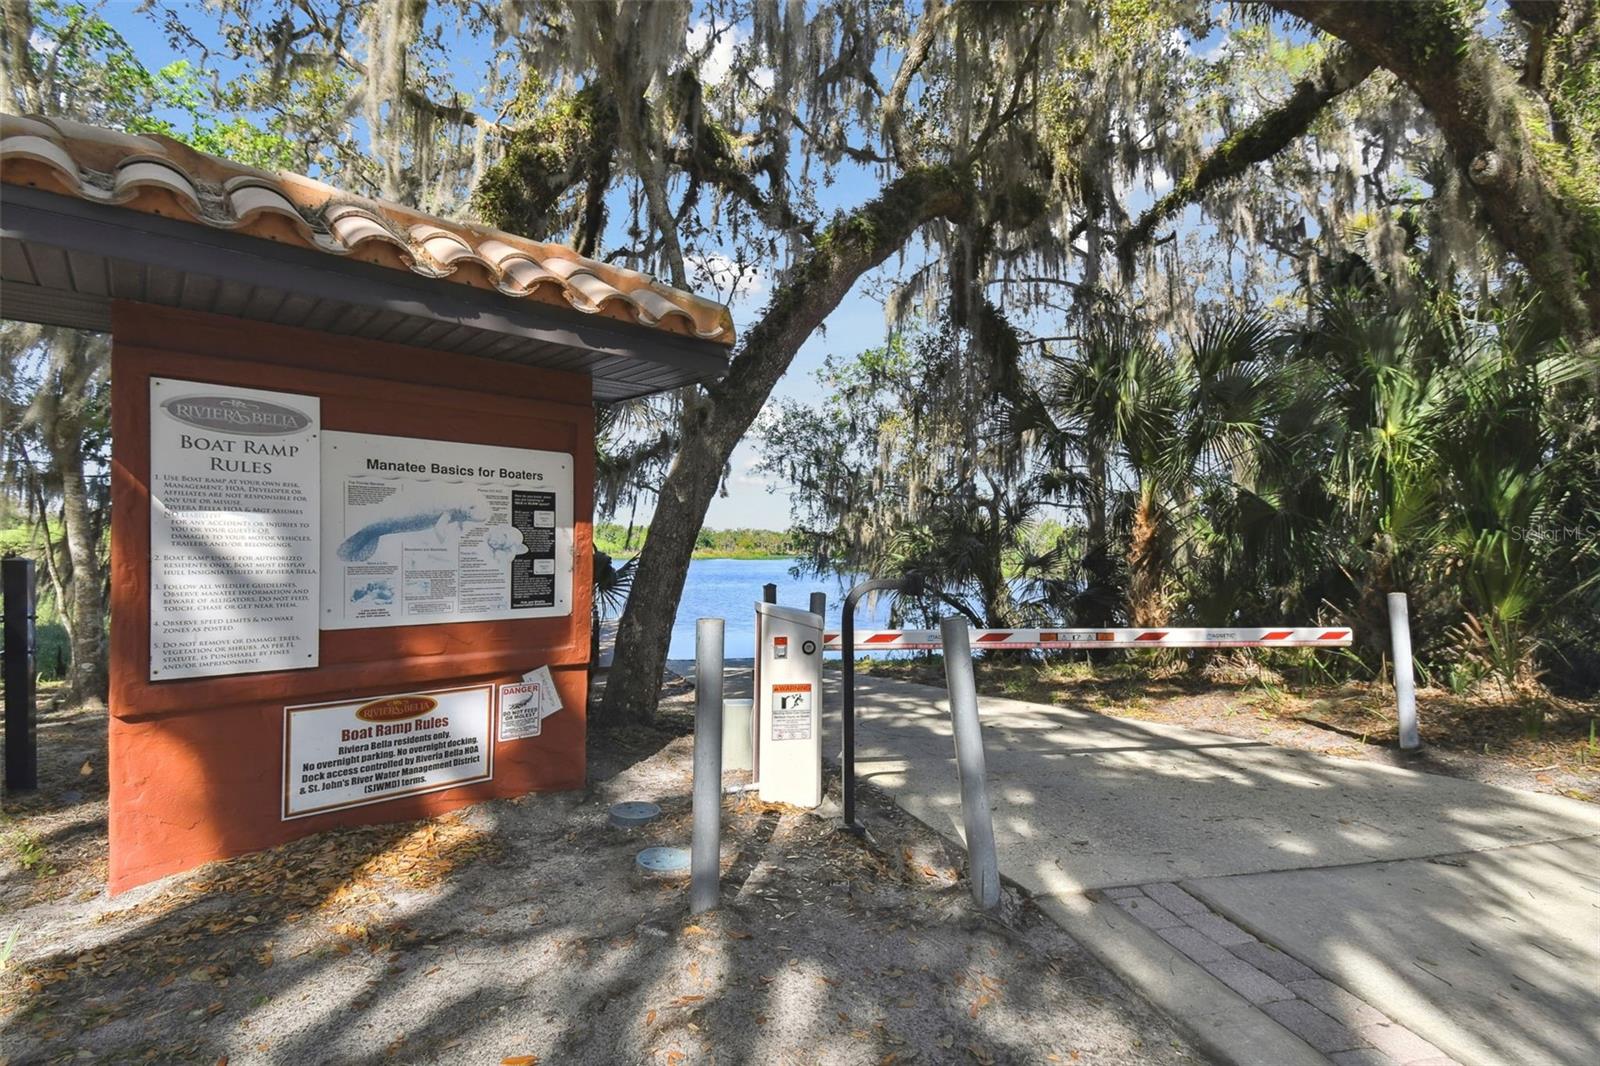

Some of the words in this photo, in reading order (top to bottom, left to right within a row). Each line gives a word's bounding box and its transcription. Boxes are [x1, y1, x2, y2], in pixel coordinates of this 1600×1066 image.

[177, 404, 249, 425] RIVIERA
[251, 412, 299, 429] BELLA
[181, 434, 236, 452] BOAT
[244, 440, 299, 457] RAMP
[210, 457, 272, 475] RULES
[366, 459, 426, 473] Manatee
[431, 463, 475, 476] Basics
[478, 466, 496, 478] for
[499, 468, 544, 481] Boaters
[503, 685, 538, 696] DANGER
[341, 727, 373, 742] Boat
[376, 722, 412, 737] Ramp
[415, 717, 449, 731] Rules
[302, 763, 314, 772] No
[316, 756, 360, 770] overnight
[361, 750, 395, 764] parking.
[397, 748, 408, 756] No
[409, 741, 446, 754] overnight
[447, 737, 478, 748] docking.
[338, 744, 369, 755] Riviera
[370, 740, 392, 750] Bella
[394, 734, 432, 746] residents
[433, 731, 451, 740] only.
[299, 787, 306, 795] &
[308, 784, 320, 794] St.
[321, 779, 350, 791] John's
[351, 775, 374, 786] River
[374, 770, 400, 780] Water
[402, 760, 452, 776] Management
[453, 755, 480, 767] District
[302, 772, 325, 784] Dock
[326, 767, 358, 779] access
[360, 760, 404, 773] controlled
[404, 757, 414, 766] by
[416, 752, 443, 763] Riveria
[444, 749, 464, 758] Bella
[464, 746, 479, 754] HOA
[364, 780, 400, 794] (SJWMD)
[402, 776, 427, 786] terms.
